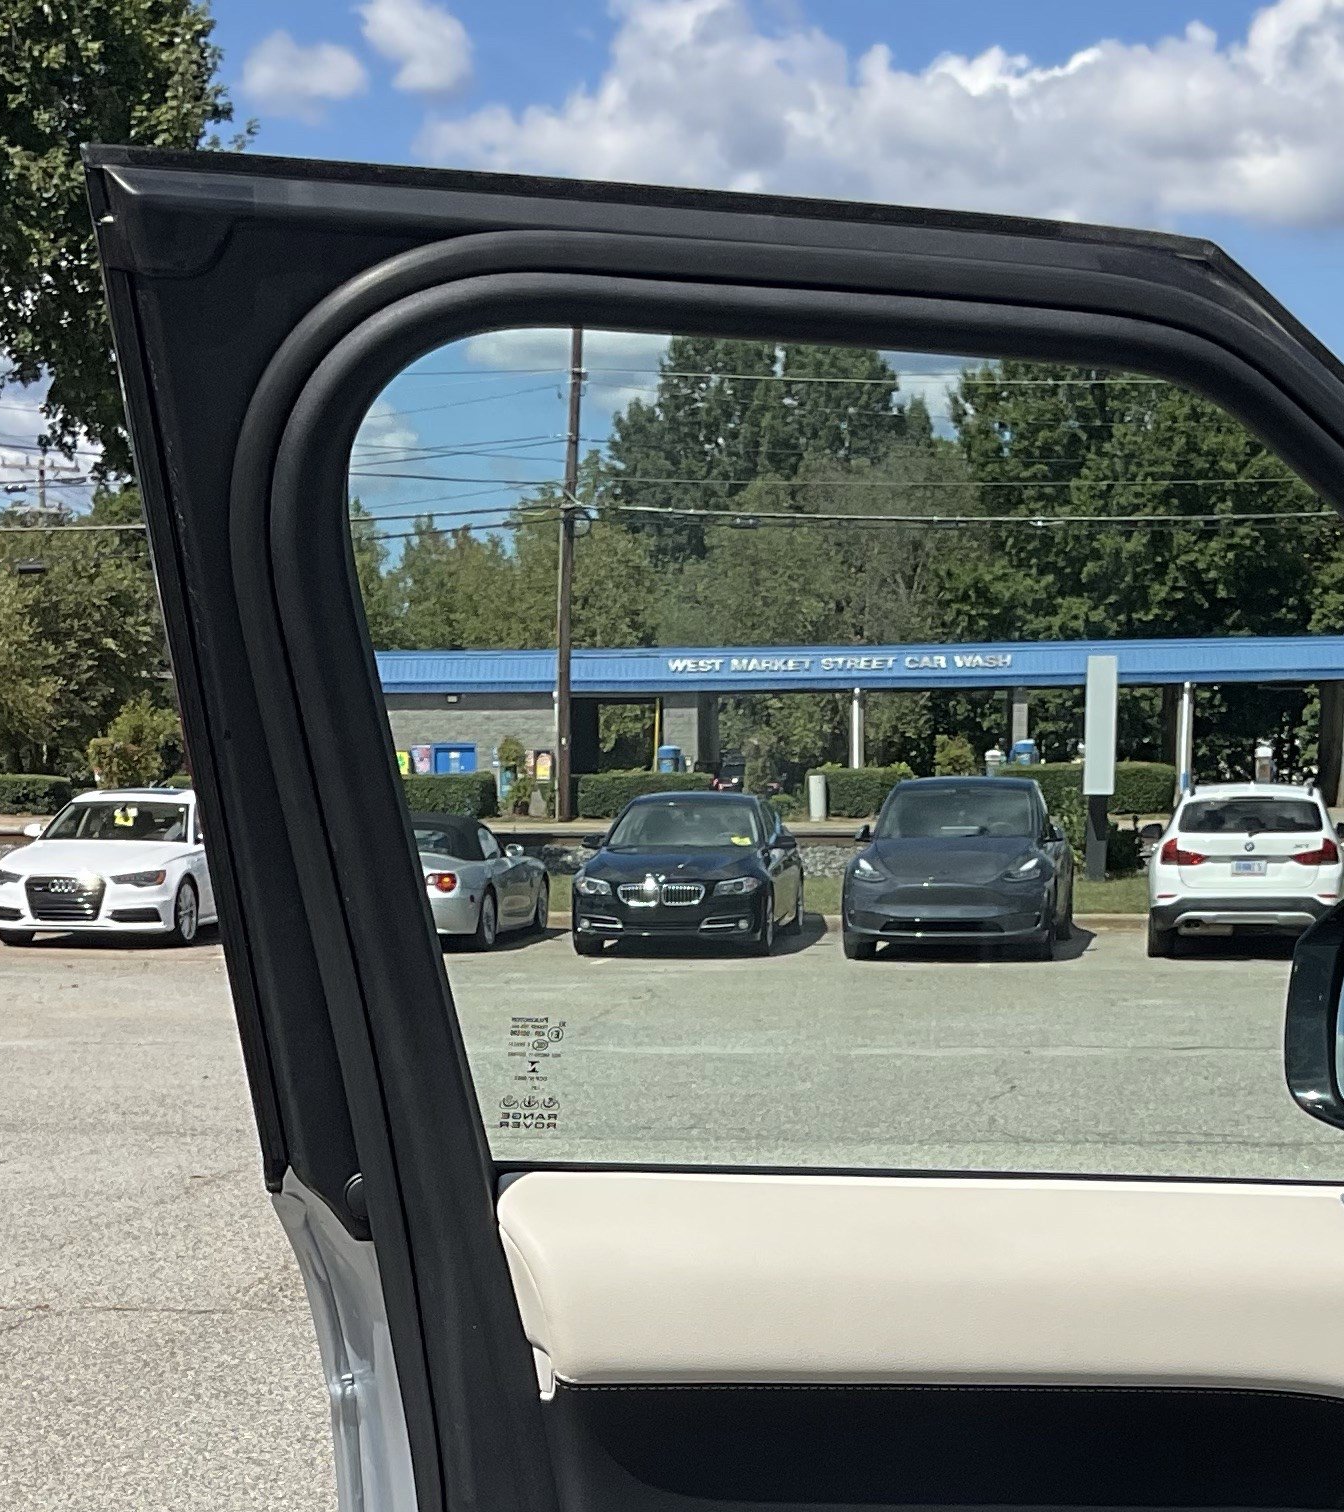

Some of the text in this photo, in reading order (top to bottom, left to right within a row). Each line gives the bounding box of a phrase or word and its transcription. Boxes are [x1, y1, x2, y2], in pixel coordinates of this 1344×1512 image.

[668, 654, 1012, 672] WEST MARKET STREET CAR WASH
